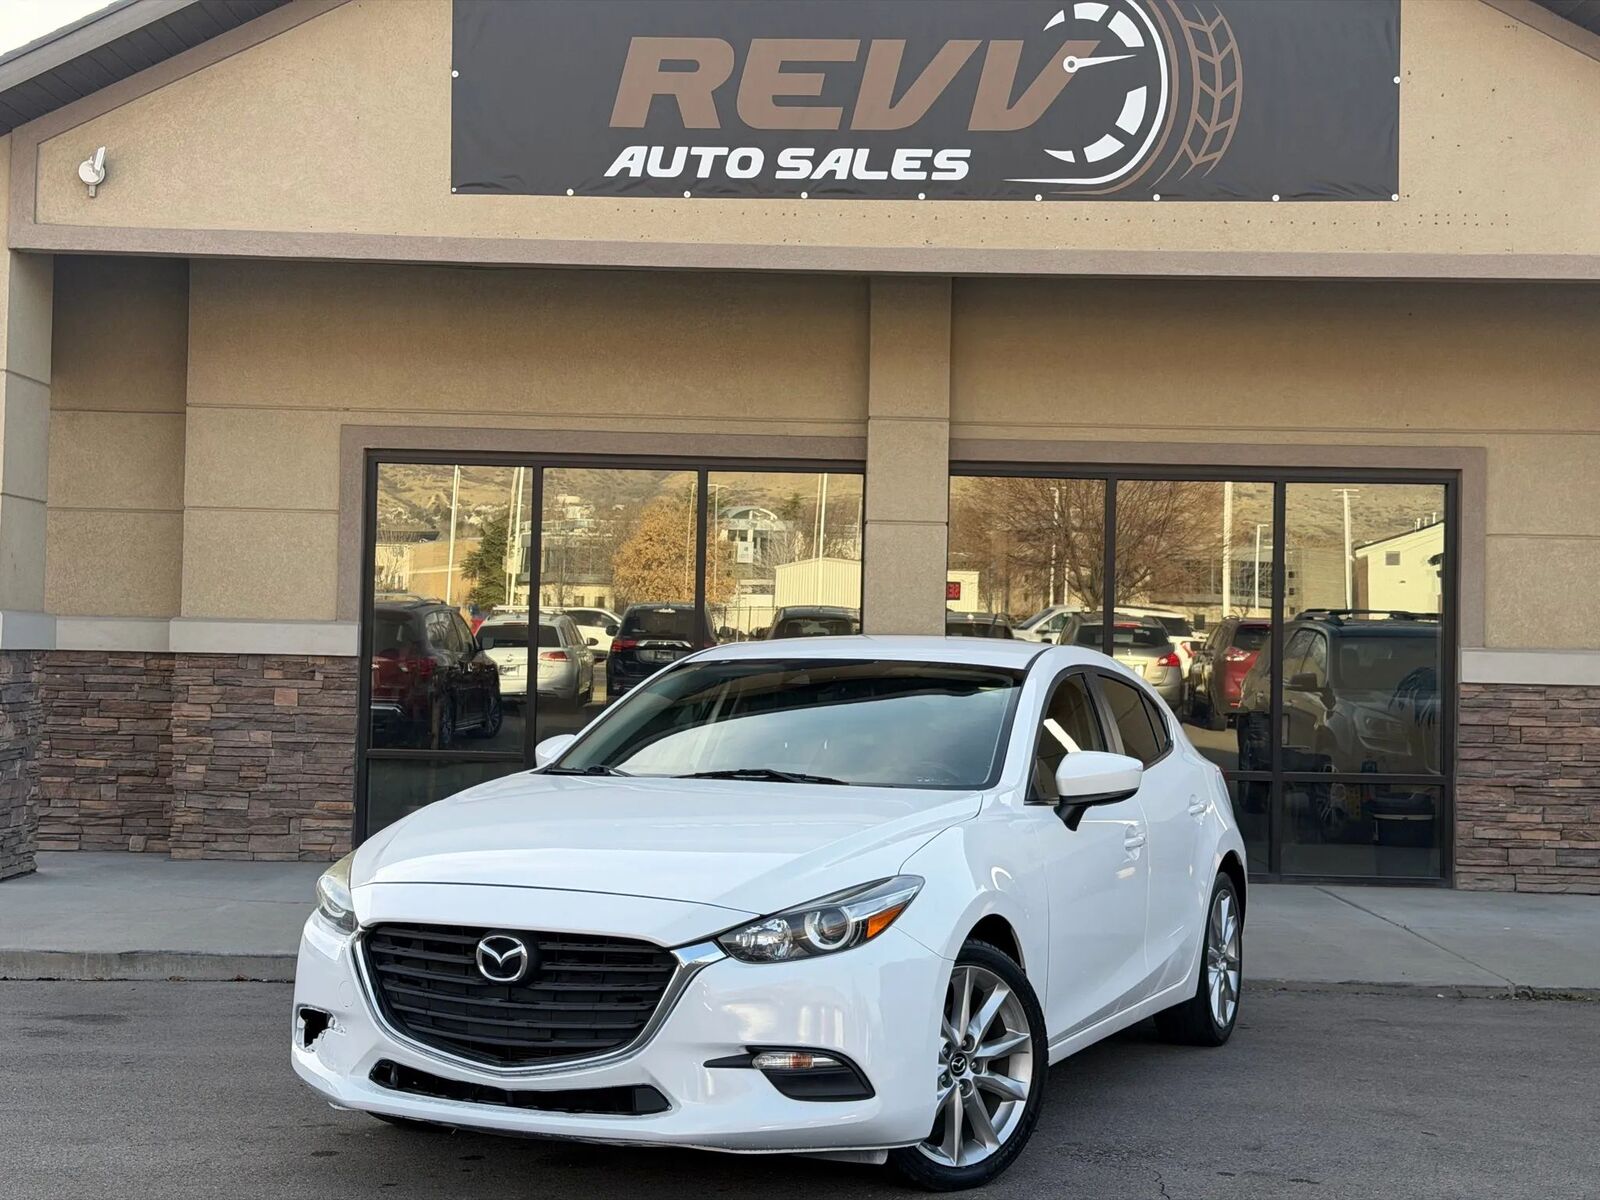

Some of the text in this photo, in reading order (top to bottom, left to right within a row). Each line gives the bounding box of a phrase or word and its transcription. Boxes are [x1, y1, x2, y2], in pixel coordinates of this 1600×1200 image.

[609, 37, 1099, 131] REVV
[603, 145, 972, 181] AUTO SALES
